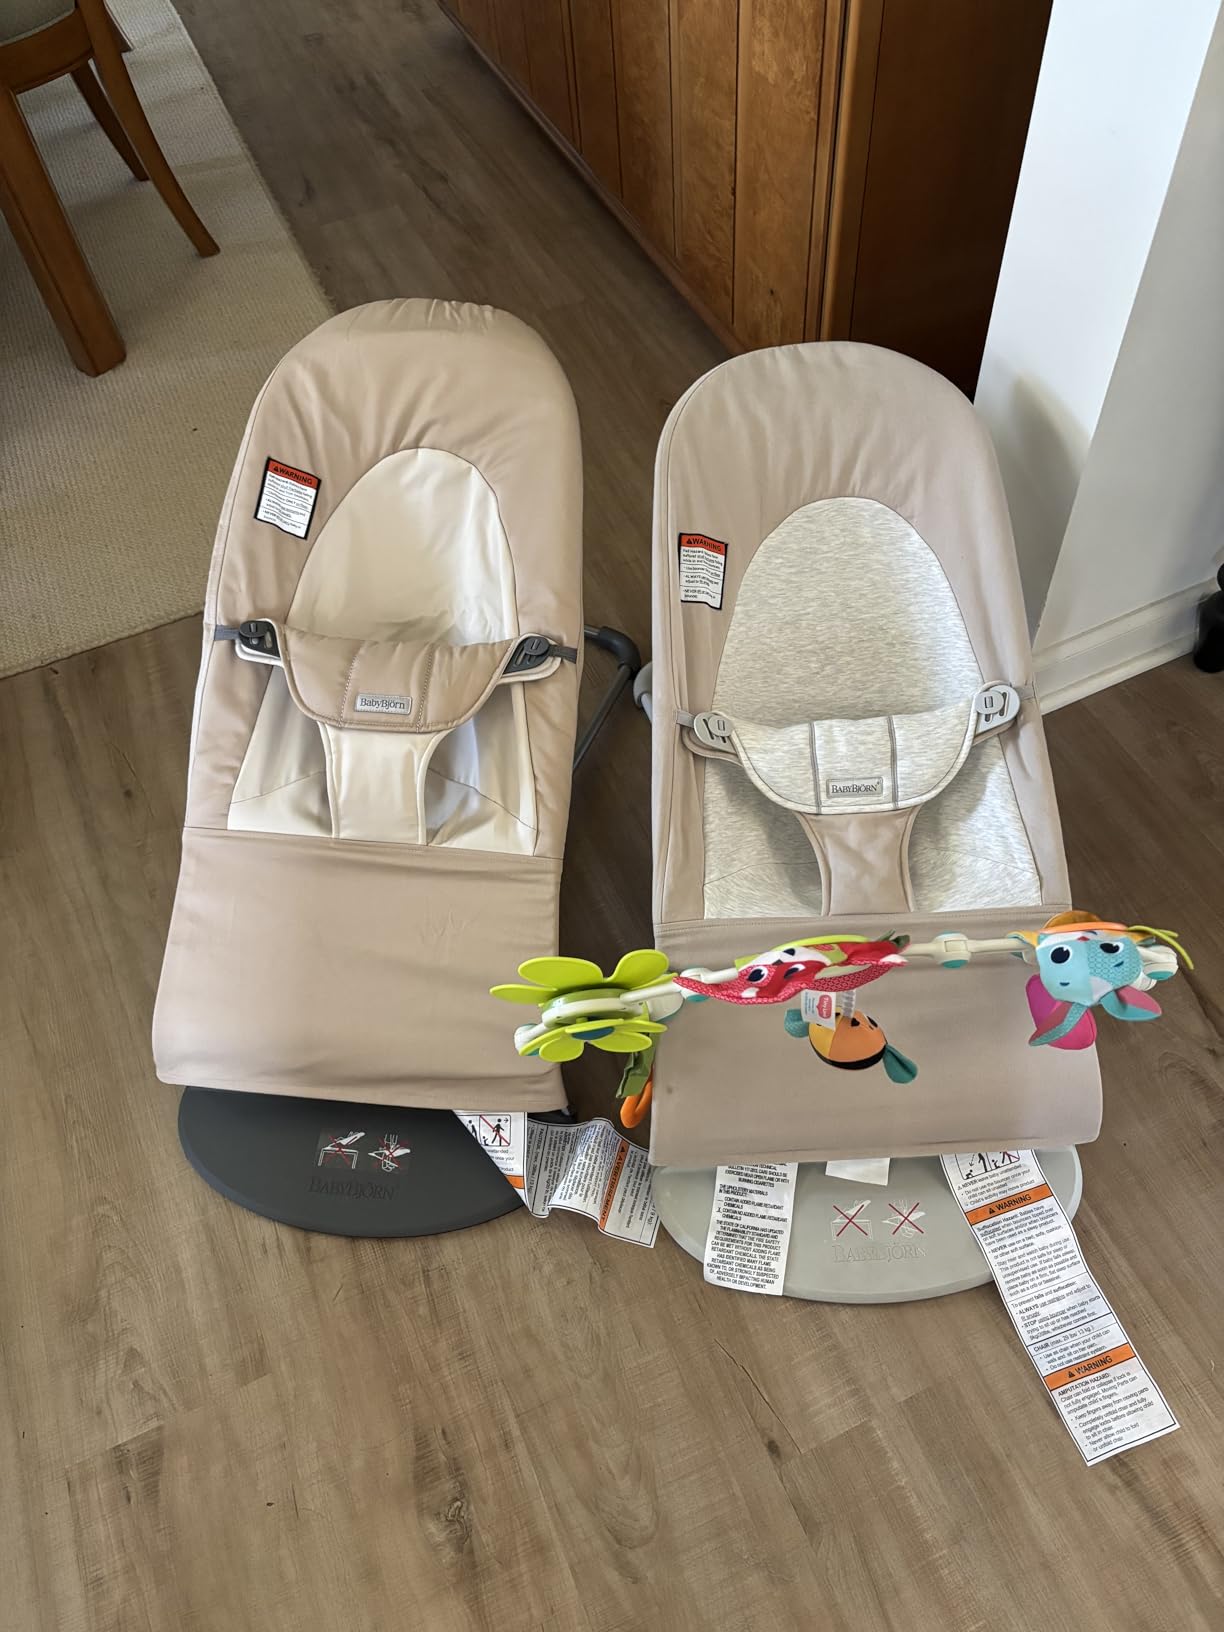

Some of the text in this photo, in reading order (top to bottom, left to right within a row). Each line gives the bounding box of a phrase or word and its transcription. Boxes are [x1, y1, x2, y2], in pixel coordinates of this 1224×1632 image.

[280, 468, 312, 484] WARNING
[692, 538, 721, 551] WARNING
[360, 698, 405, 710] BabyBjörn
[995, 1194, 1031, 1211] WARNING
[1075, 1355, 1112, 1375] WARNING
